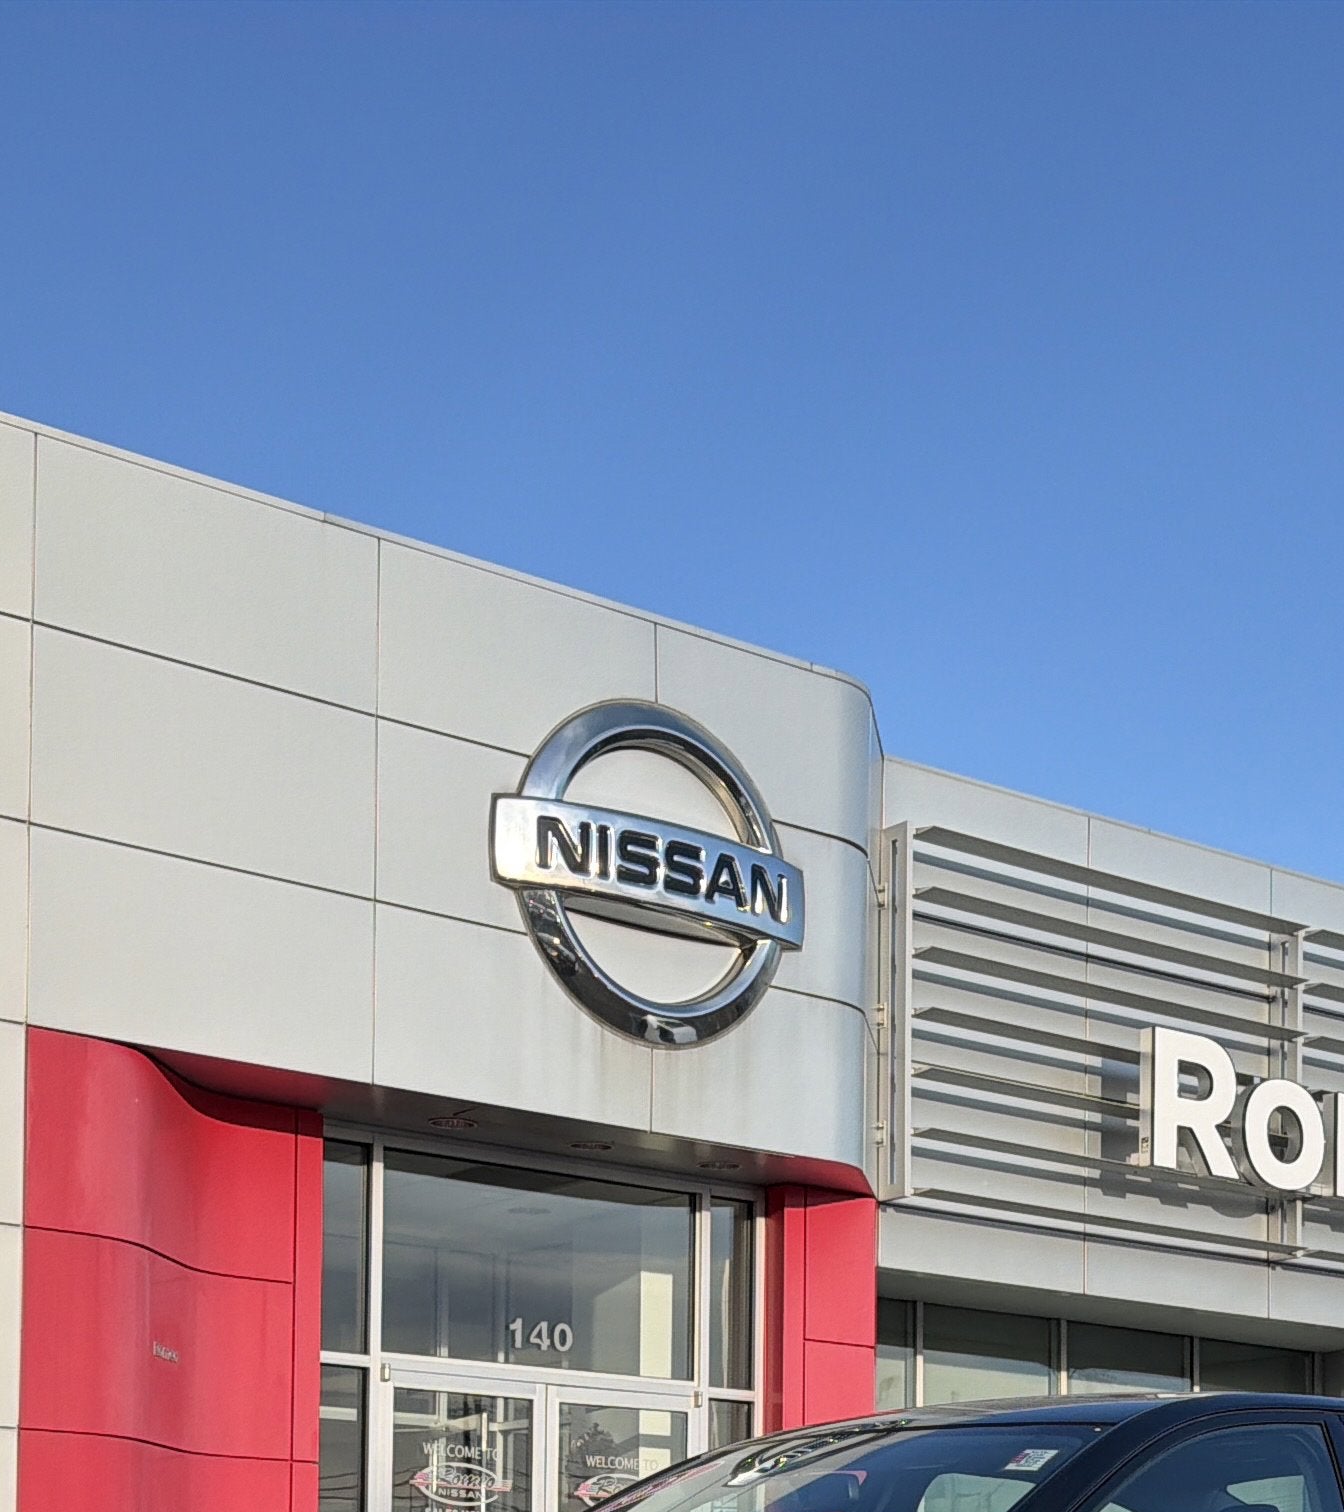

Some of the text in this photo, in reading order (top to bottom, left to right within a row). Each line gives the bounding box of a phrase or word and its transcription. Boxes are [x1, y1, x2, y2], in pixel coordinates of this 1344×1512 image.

[535, 814, 792, 924] NISSAN
[509, 1317, 573, 1352] 140
[422, 1441, 499, 1461] WELCOME TO
[585, 1454, 658, 1470] WELCOME TO
[438, 1487, 485, 1499] NISSAN
